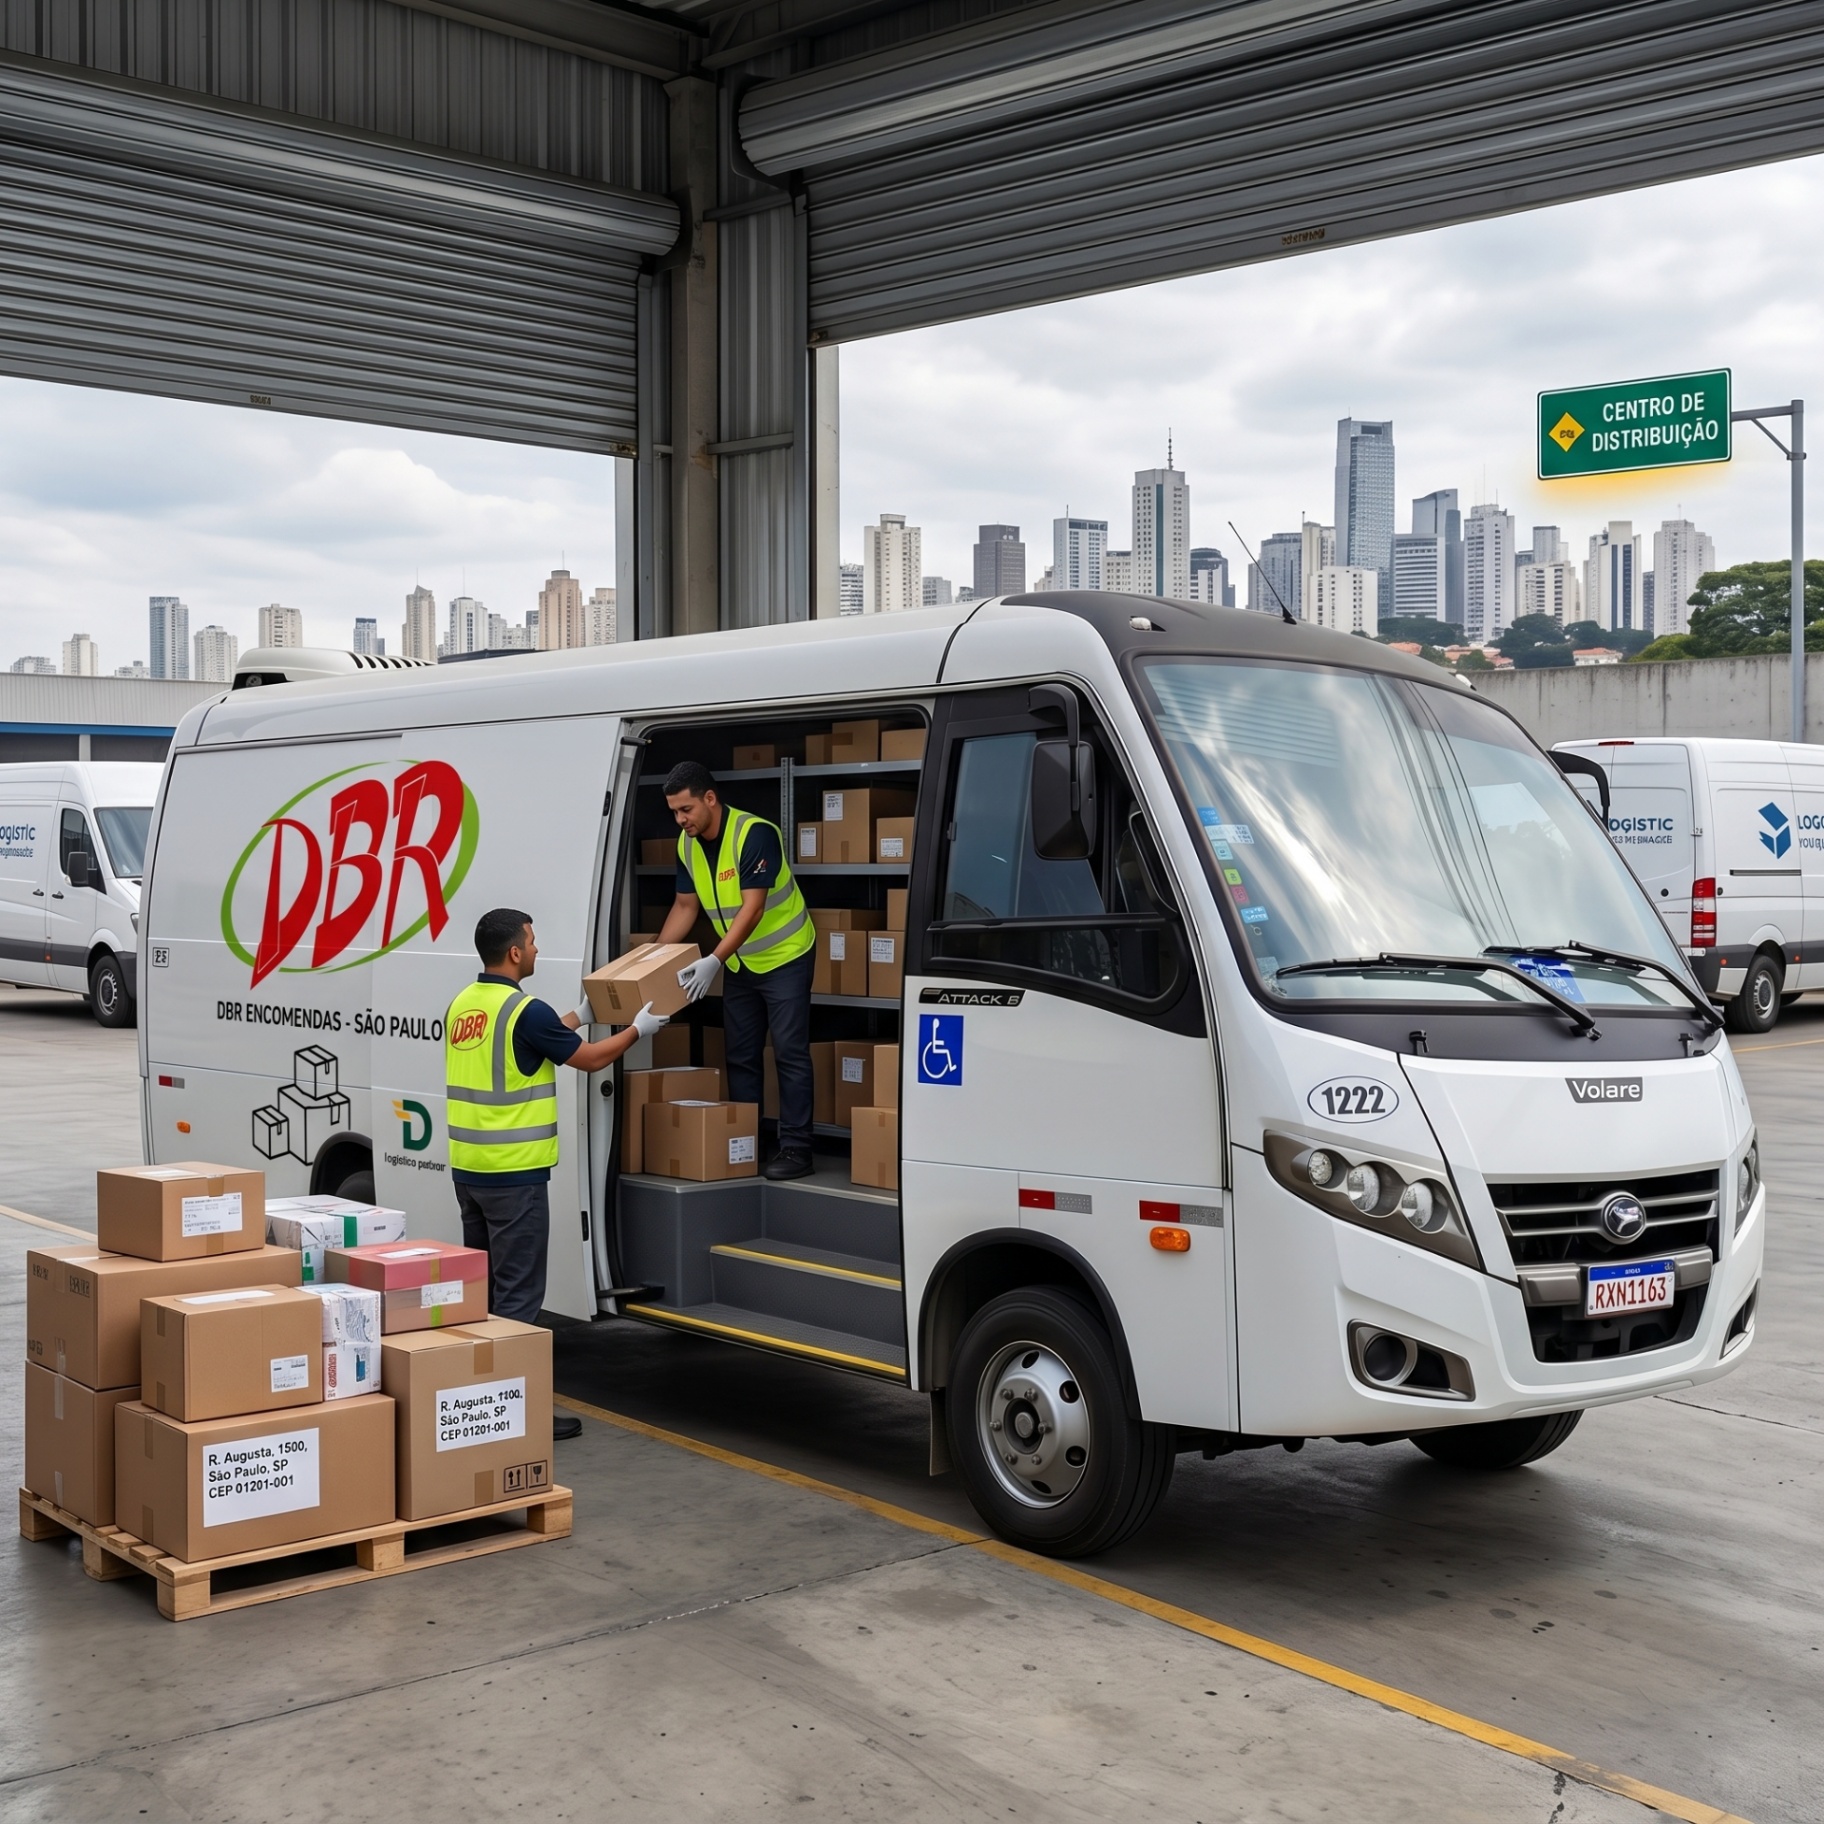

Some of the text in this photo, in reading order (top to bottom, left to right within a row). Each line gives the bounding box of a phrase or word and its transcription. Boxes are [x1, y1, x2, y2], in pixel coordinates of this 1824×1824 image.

[1602, 391, 1705, 422] CENTRO DE
[1592, 417, 1719, 452] DISTRIBUIÇÃO
[1609, 817, 1674, 833] OGISTIC
[250, 760, 465, 991] DBR
[938, 994, 1003, 1005] ATTACK
[217, 1000, 243, 1022] DBR
[246, 1003, 342, 1032] ENCOMENDAS
[354, 1008, 386, 1036] SÃO
[390, 1016, 443, 1042] PAULO
[1321, 1085, 1386, 1115] 1222
[1571, 1080, 1640, 1099] Volare
[1595, 1276, 1667, 1310] RXN1163
[494, 1405, 507, 1418] SP
[441, 1420, 510, 1441] CEP 01201-001
[208, 1454, 221, 1467] R.
[278, 1440, 308, 1455] 1500,
[234, 1464, 270, 1479] Paulo,
[273, 1459, 289, 1472] SP
[209, 1474, 294, 1499] CEP 01201-001
